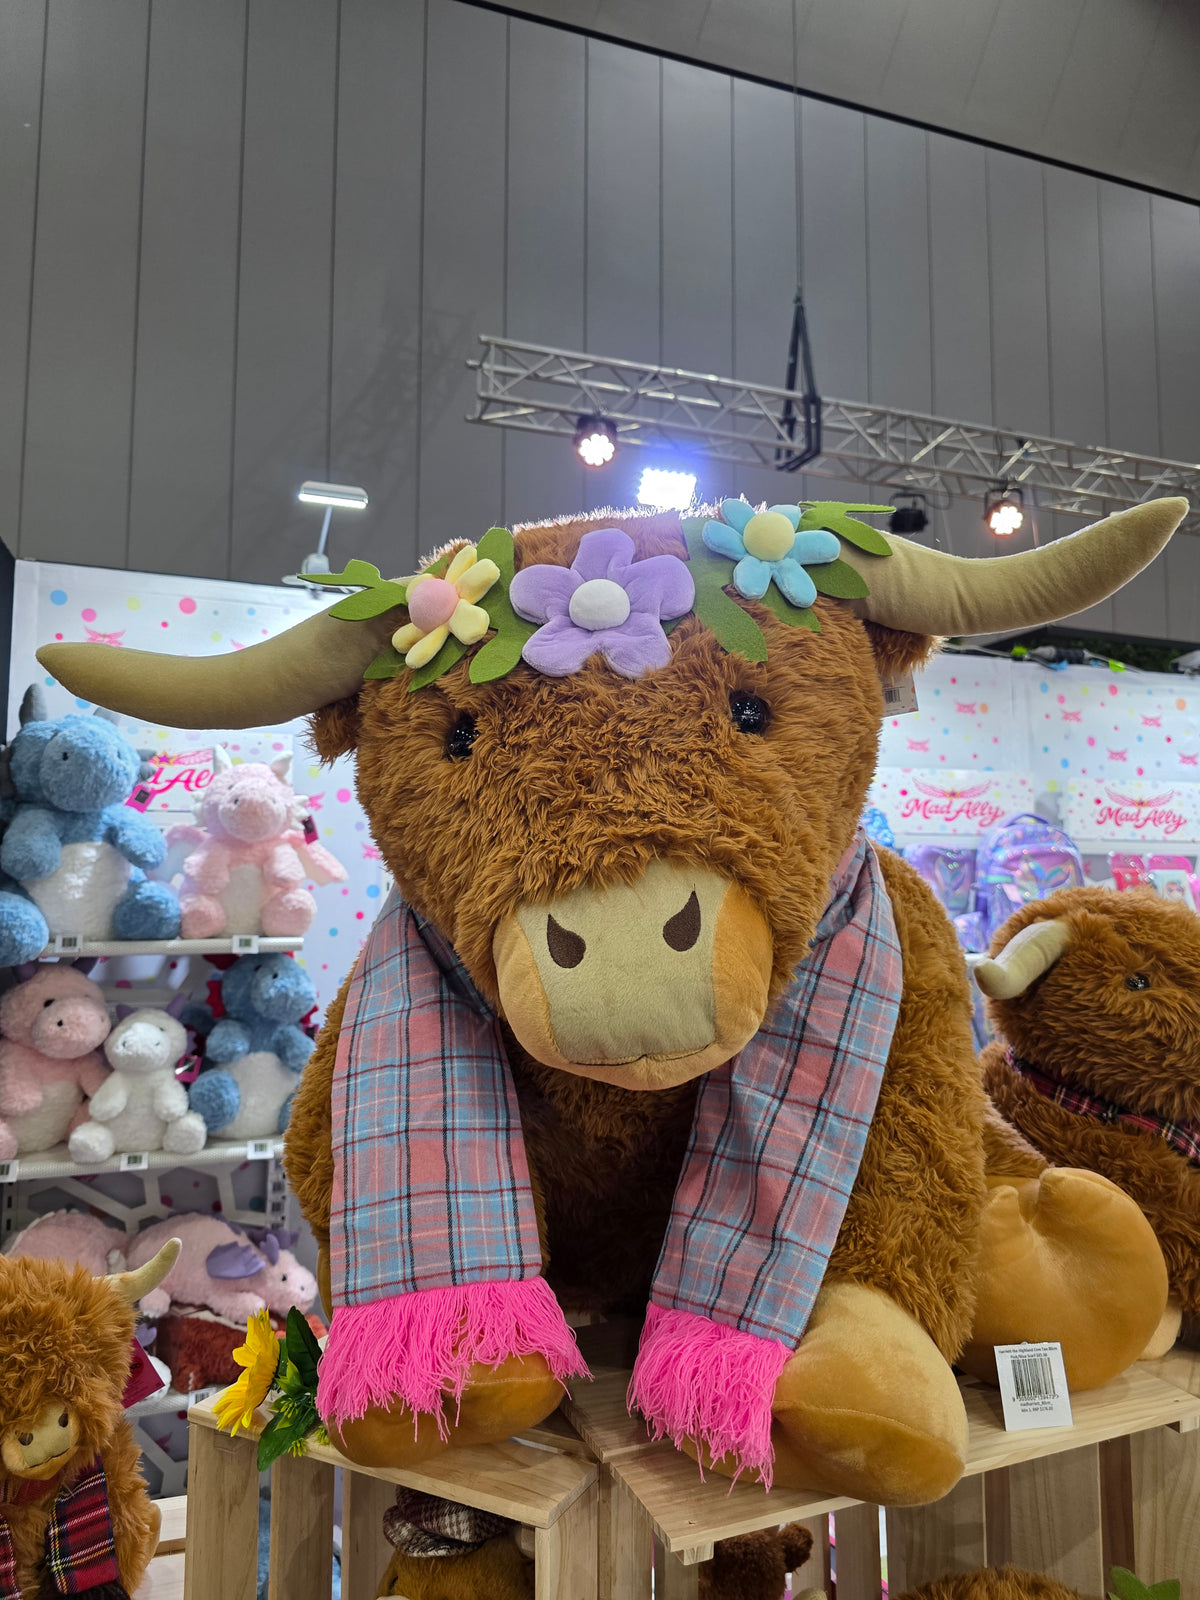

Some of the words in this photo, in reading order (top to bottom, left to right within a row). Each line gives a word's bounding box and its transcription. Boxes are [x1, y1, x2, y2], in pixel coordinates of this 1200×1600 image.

[901, 798, 953, 819] Mad
[944, 801, 1005, 827] Ally
[1096, 806, 1142, 827] Mad
[1134, 809, 1187, 834] Ally
